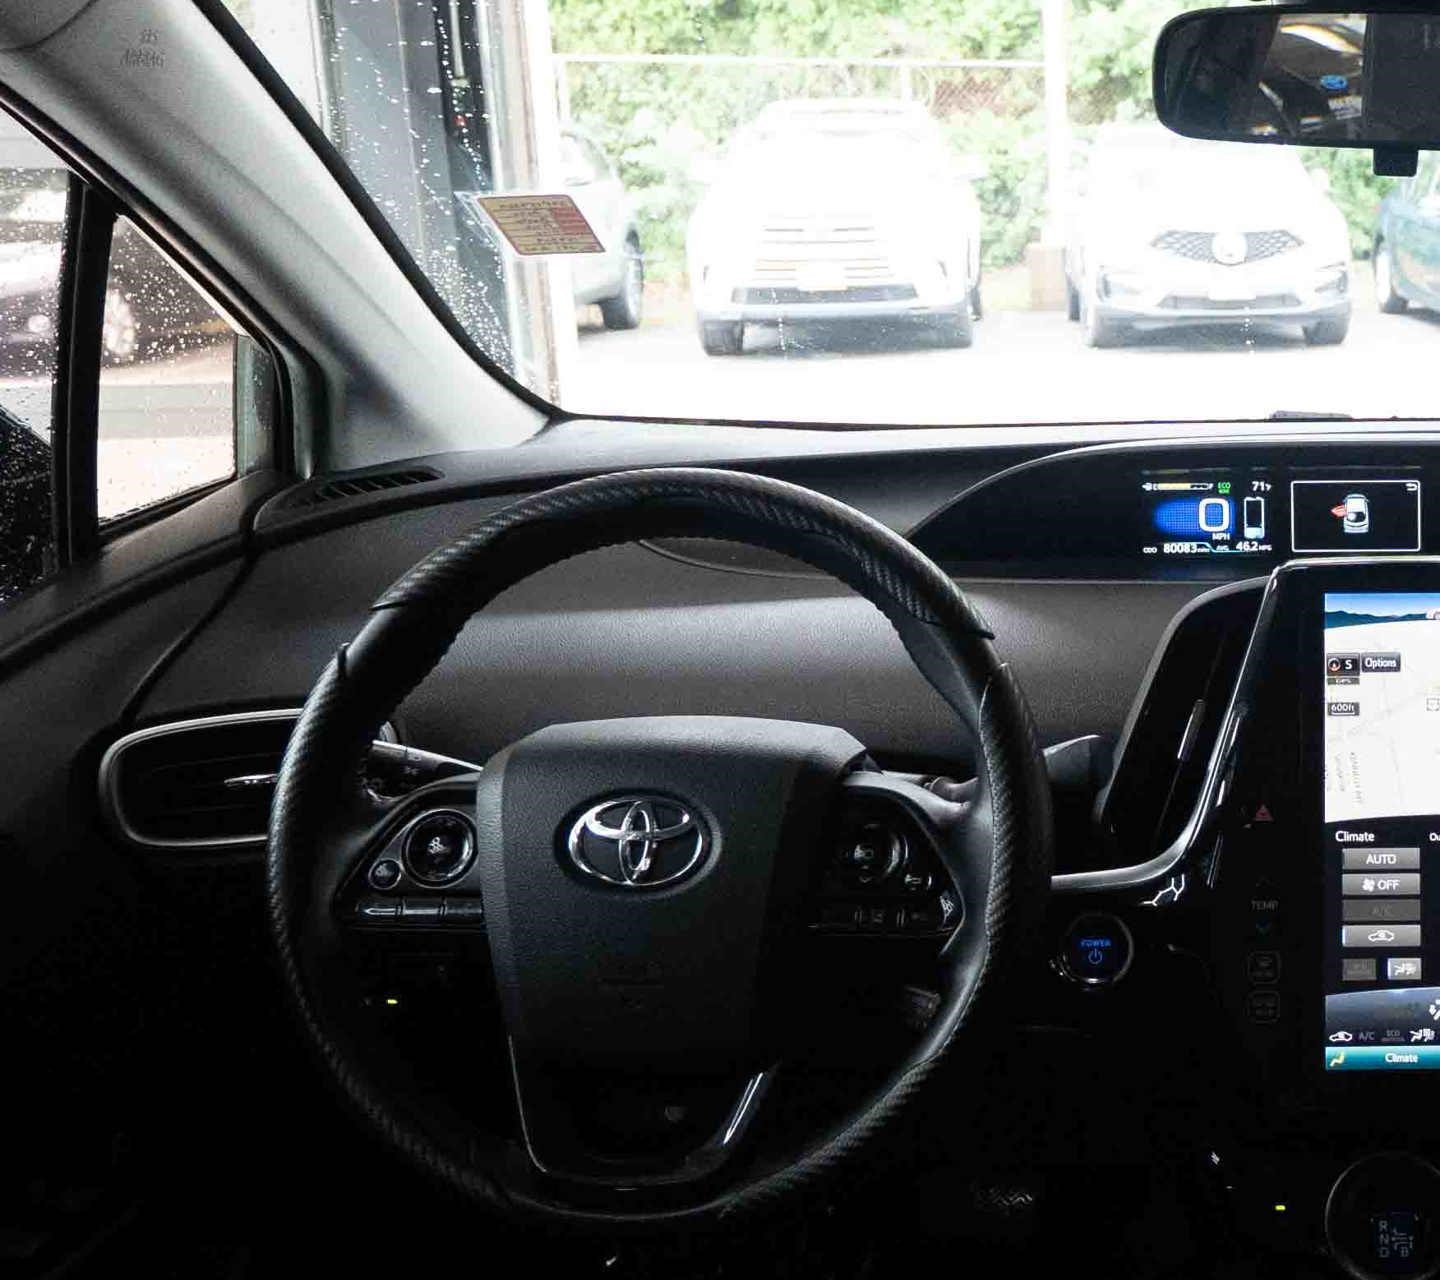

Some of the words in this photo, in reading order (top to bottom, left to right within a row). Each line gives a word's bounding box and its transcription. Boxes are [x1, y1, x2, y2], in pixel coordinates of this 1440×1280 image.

[1199, 498, 1229, 532] 0
[1212, 532, 1230, 541] MPH
[1345, 659, 1353, 670] S
[1365, 656, 1396, 670] Options
[1335, 831, 1375, 842] Climate
[1366, 854, 1397, 864] AUTO
[1377, 880, 1400, 890] OFF
[1358, 1031, 1375, 1041] A/C
[1385, 1052, 1418, 1063] Climate
[1379, 1220, 1388, 1232] R
[1378, 1234, 1389, 1245] N
